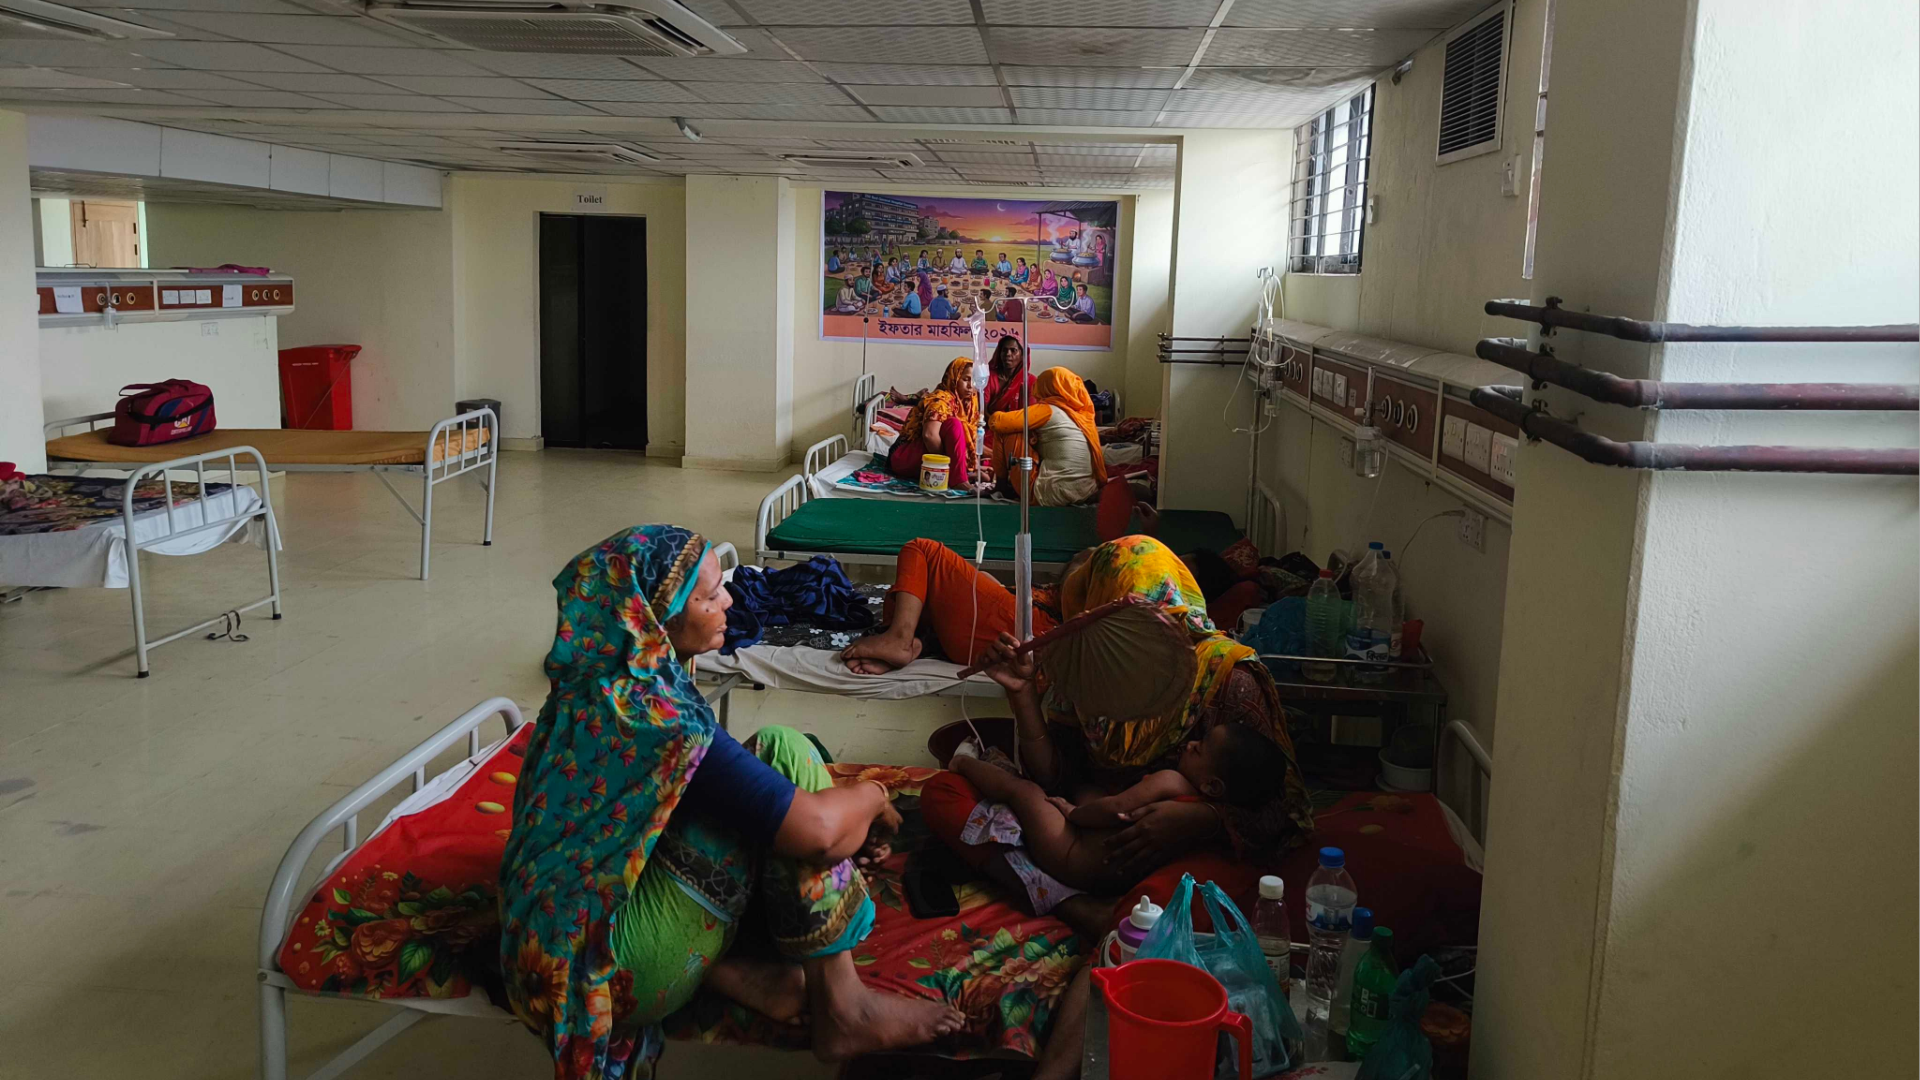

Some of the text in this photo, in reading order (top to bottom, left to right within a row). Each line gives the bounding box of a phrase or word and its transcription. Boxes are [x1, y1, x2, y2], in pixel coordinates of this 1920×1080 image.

[577, 194, 602, 204] Toilet
[878, 318, 922, 337] ইফতার
[927, 321, 973, 338] মাহফিল
